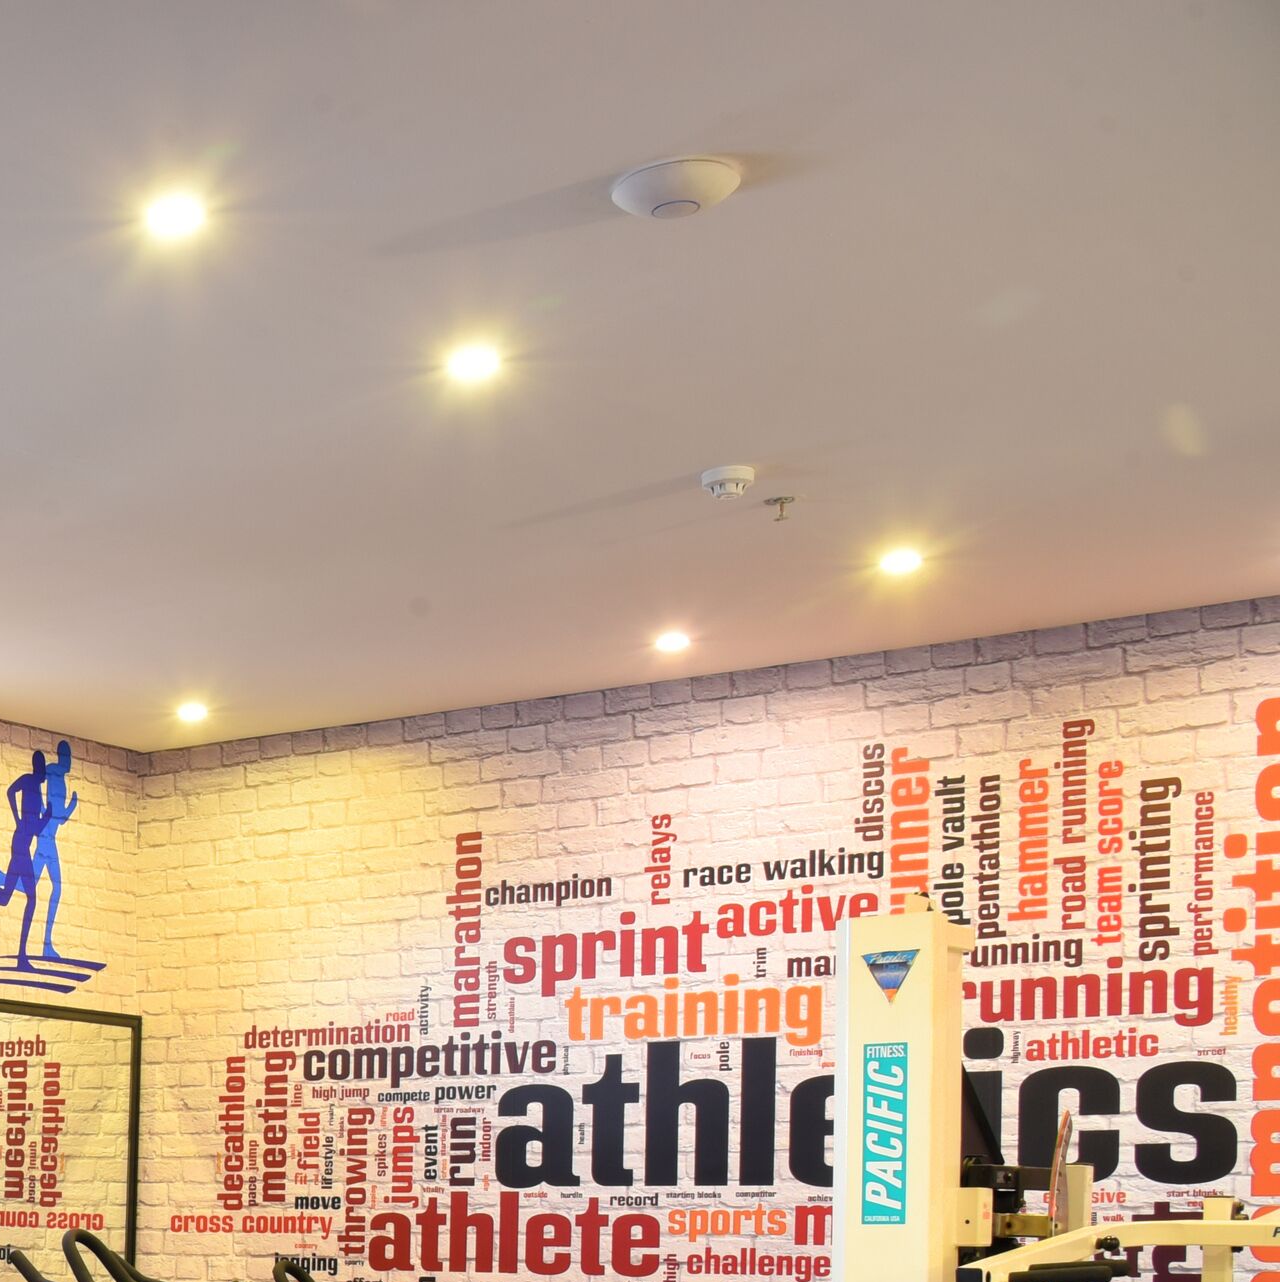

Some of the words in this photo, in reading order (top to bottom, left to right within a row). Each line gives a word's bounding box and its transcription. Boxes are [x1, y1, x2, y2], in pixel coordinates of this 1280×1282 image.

[855, 743, 885, 841] discus
[1054, 719, 1095, 844] running
[1097, 760, 1124, 854] score
[935, 775, 965, 852] vault
[1008, 759, 1049, 921] hammer
[645, 814, 677, 905] relays
[683, 862, 751, 887] race
[763, 848, 884, 879] walking
[971, 774, 1006, 939] pentathlon
[1128, 777, 1182, 961] sprinting
[1187, 791, 1219, 956] performance
[485, 873, 612, 906] champion
[717, 884, 878, 938] active
[1053, 856, 1086, 930] road
[1090, 866, 1122, 946] team
[446, 831, 482, 1028] marathon
[503, 911, 709, 997] sprint
[485, 961, 498, 1020] strength
[753, 947, 767, 978] trim
[244, 1018, 411, 1050] determination
[386, 1008, 415, 1022] road
[417, 985, 433, 1036] activity
[565, 973, 823, 1047] training
[1219, 975, 1242, 1037] healthy
[303, 1030, 557, 1088] competitive
[716, 1041, 733, 1072] pole
[866, 1044, 906, 1059] FITNESS
[1025, 1027, 1160, 1062] athletic
[290, 1084, 302, 1107] line
[311, 1086, 337, 1101] high
[338, 1085, 370, 1101] jump
[377, 1089, 430, 1104] compete
[434, 1084, 497, 1105] power
[495, 1027, 1238, 1189] athleics
[217, 1056, 246, 1211] decathlon
[256, 1050, 297, 1203] meeting
[297, 1112, 321, 1170] field
[375, 1133, 387, 1178] spikes
[423, 1124, 439, 1181] event
[449, 1116, 477, 1187] run
[479, 1117, 492, 1163] indoor
[865, 1060, 905, 1211] PACIFIC
[246, 1139, 259, 1173] jump
[321, 1136, 337, 1190] lifestyle
[337, 1107, 375, 1256] throwing
[383, 1106, 421, 1208] jumps
[248, 1176, 257, 1207] pace
[294, 1195, 342, 1210] move
[609, 1193, 659, 1206] record
[1102, 1213, 1125, 1223] walk
[170, 1214, 234, 1233] cross
[241, 1211, 333, 1240] country
[368, 1191, 661, 1277] athlete
[667, 1203, 788, 1243] sports
